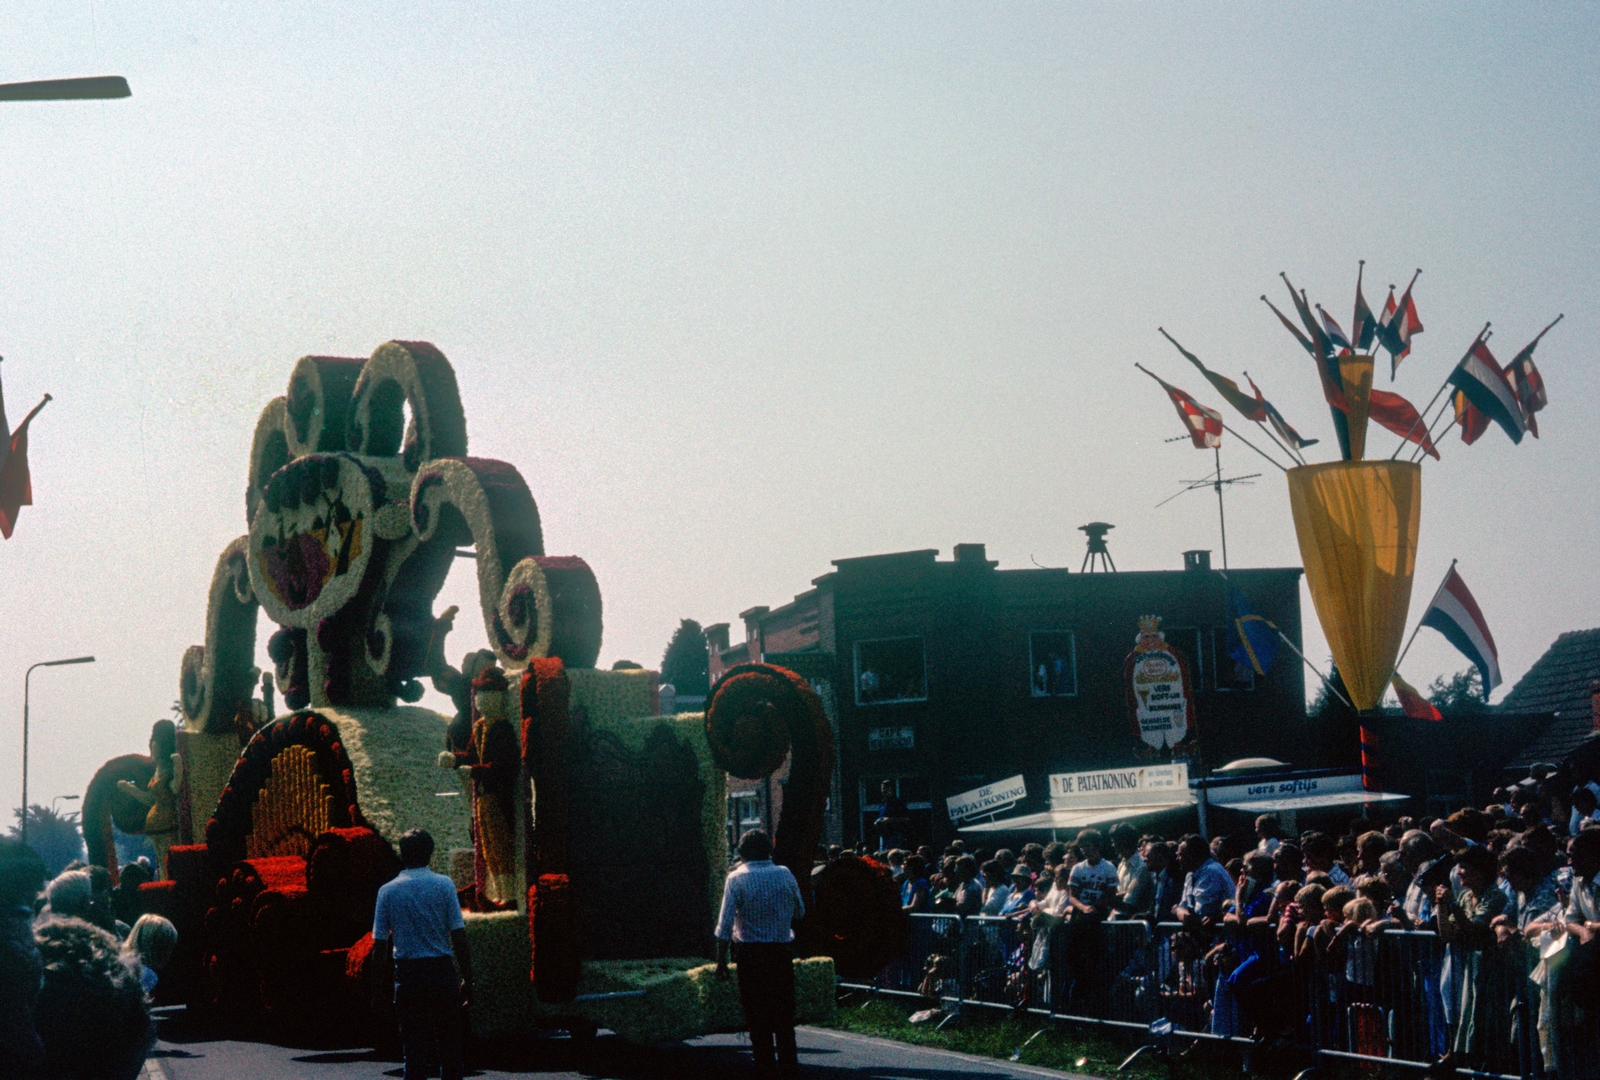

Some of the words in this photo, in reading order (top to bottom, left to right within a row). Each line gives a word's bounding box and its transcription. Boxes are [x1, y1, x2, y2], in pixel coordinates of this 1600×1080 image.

[1062, 777, 1074, 793] DE
[1077, 772, 1138, 792] PATATKONING
[1248, 785, 1275, 795] vers
[1279, 778, 1318, 793] softijs
[950, 787, 1024, 816] PATATKONING
[979, 787, 993, 798] DE
